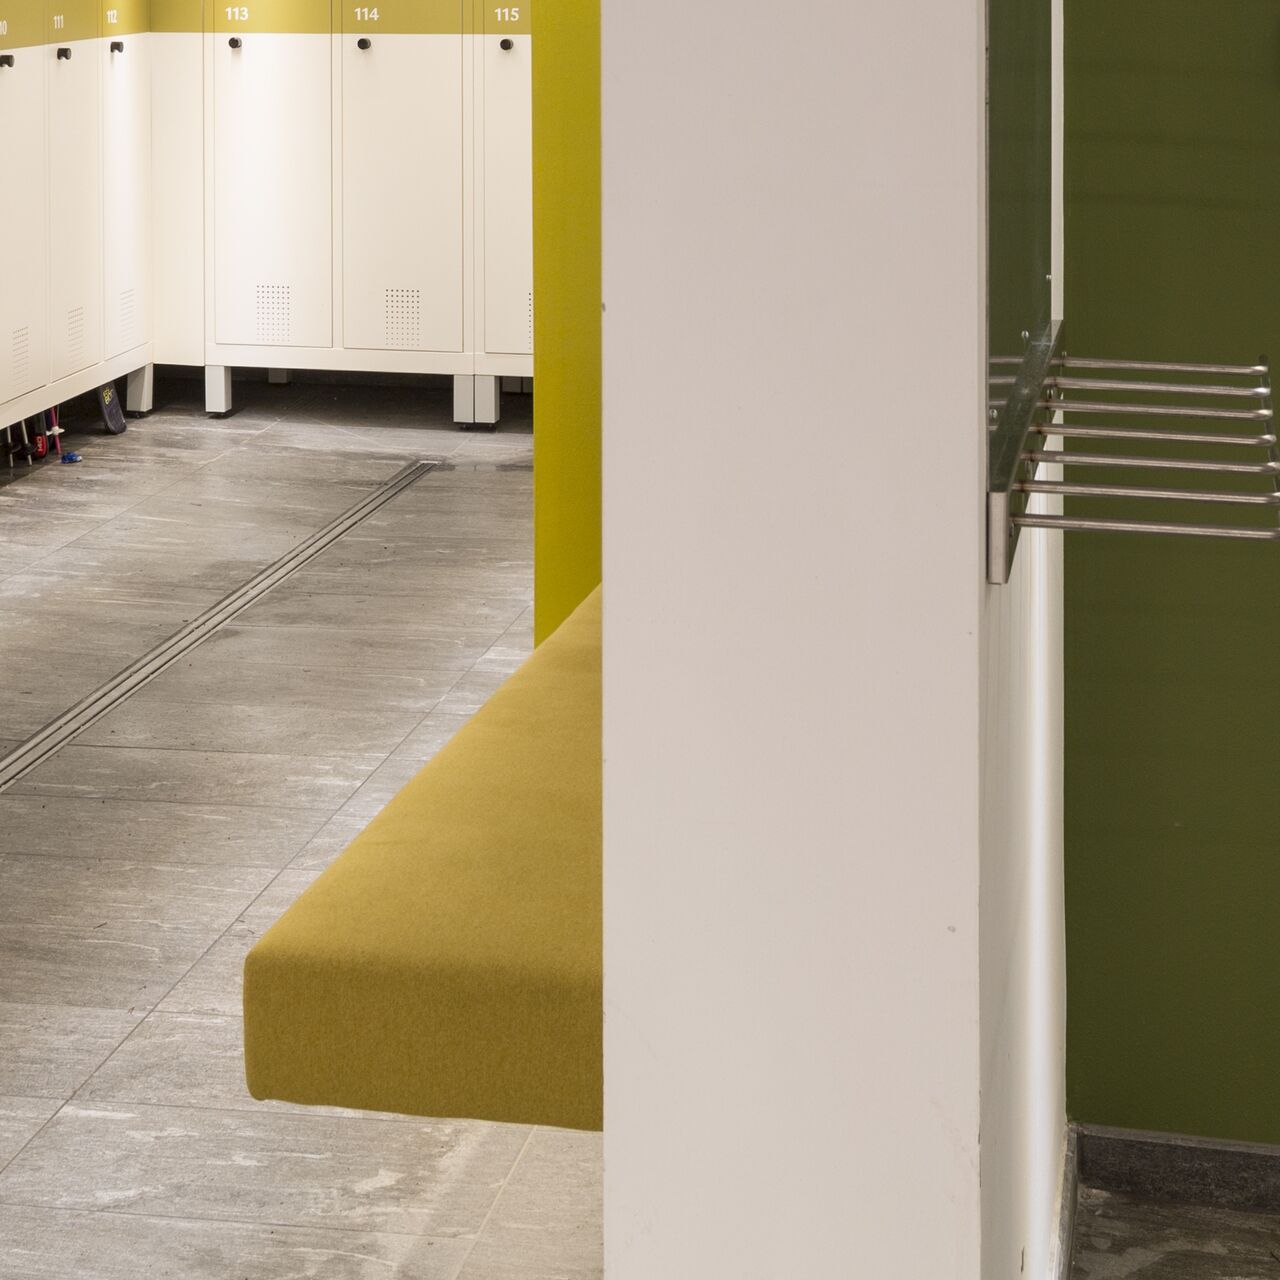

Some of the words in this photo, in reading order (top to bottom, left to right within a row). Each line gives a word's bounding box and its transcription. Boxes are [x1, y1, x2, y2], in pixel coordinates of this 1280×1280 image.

[106, 9, 118, 25] 112
[225, 6, 249, 21] 113
[354, 7, 380, 21] 114
[494, 7, 520, 22] 115
[53, 14, 64, 29] 111
